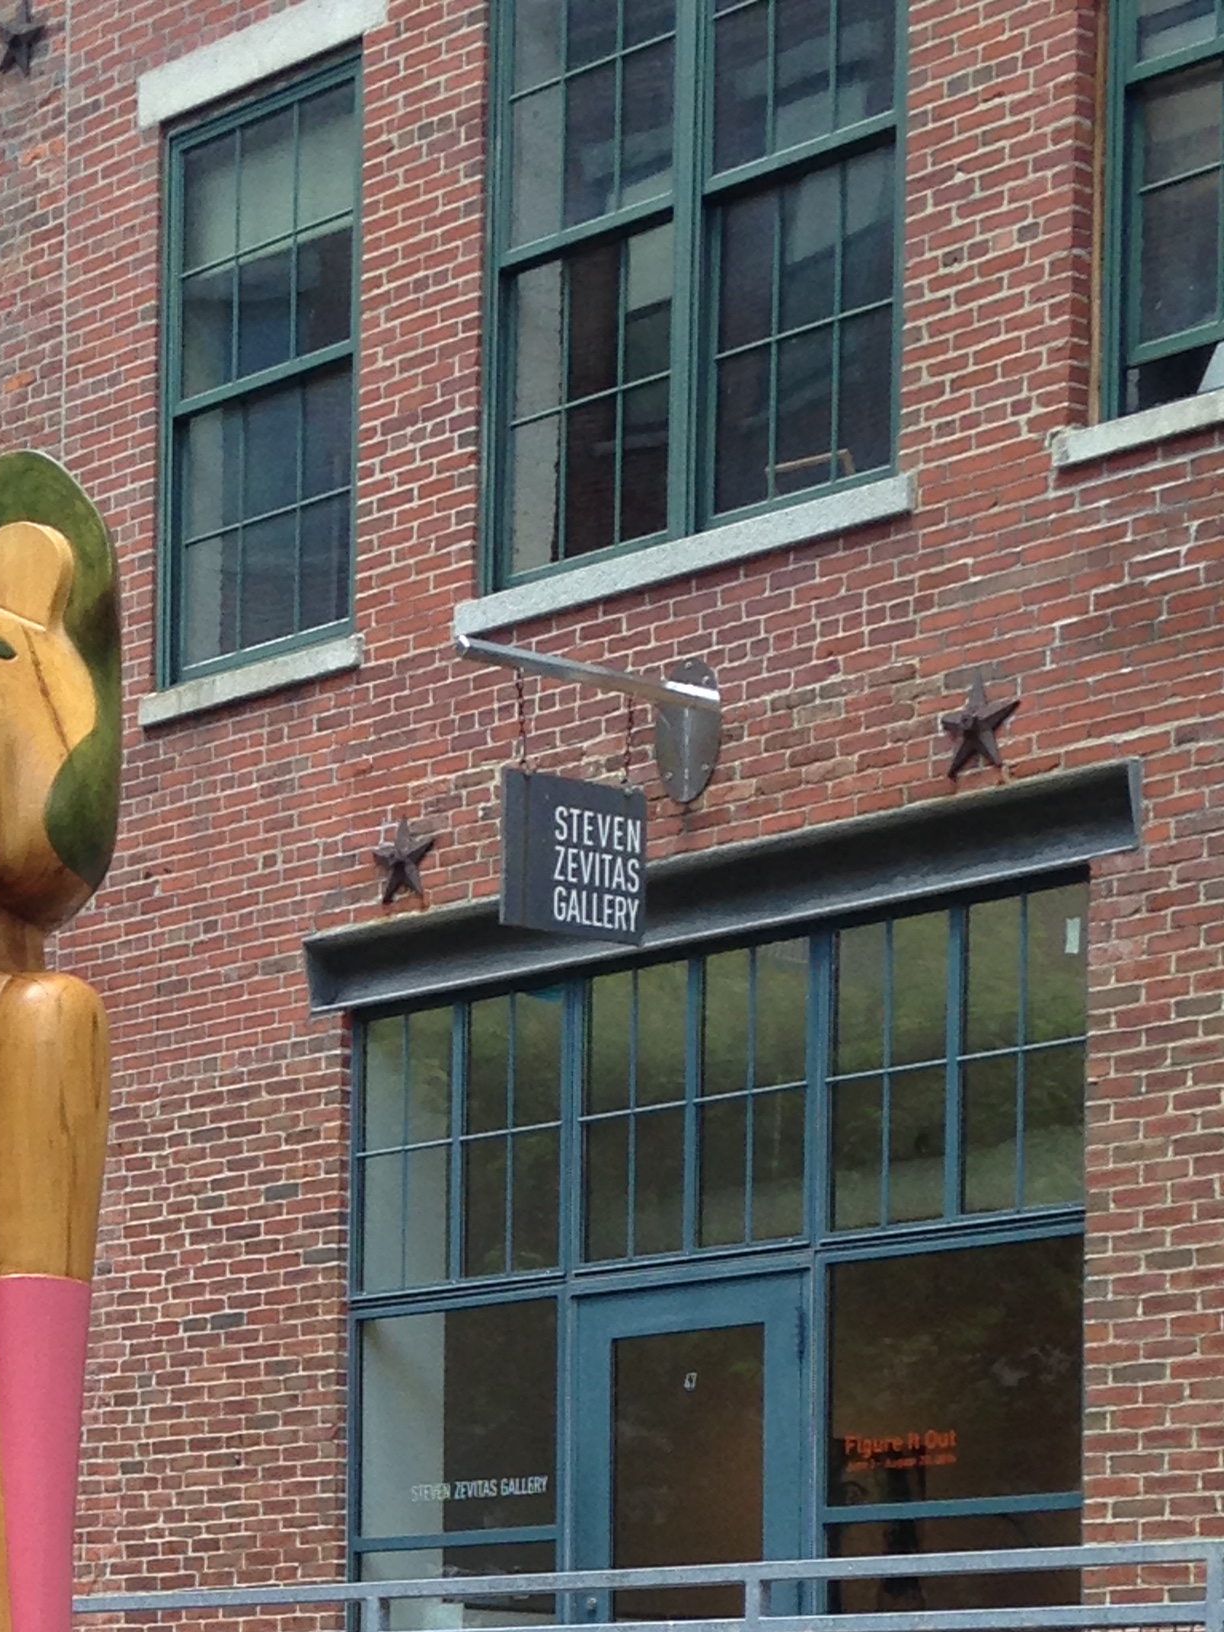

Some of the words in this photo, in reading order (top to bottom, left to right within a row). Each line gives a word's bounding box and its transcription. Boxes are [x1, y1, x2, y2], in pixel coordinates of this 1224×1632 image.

[554, 806, 641, 854] STEVEN
[554, 847, 640, 893] ZEVITAS
[553, 886, 640, 933] GALLERY
[844, 1434, 903, 1457] Figure
[924, 1429, 957, 1450] Out
[411, 1483, 451, 1502] STEVEN
[454, 1479, 497, 1500] ZEVITAS
[500, 1476, 549, 1496] GALLERY
